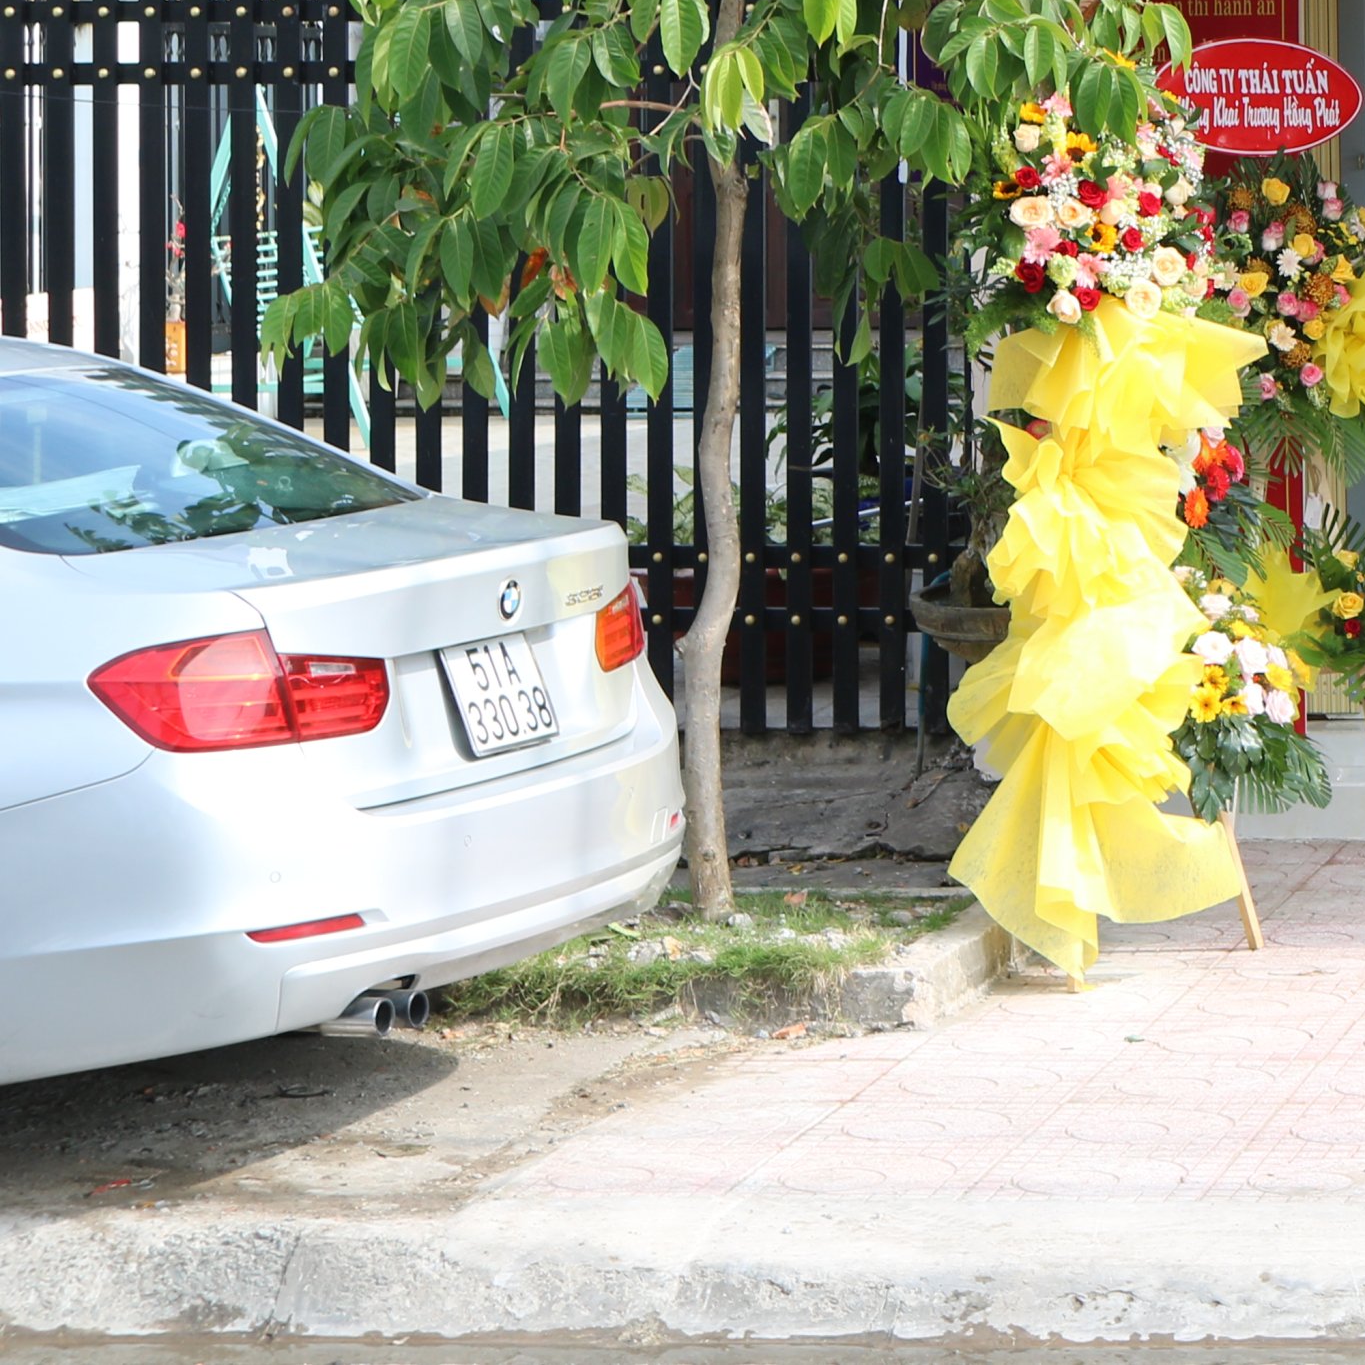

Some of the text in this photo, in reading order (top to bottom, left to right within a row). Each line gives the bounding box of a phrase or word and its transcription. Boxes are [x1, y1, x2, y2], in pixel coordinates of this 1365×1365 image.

[1184, 58, 1329, 94] CÔNG TY THÁI TUẤN
[1213, 96, 1240, 128] Khai
[1284, 96, 1313, 134] Hồng
[1314, 96, 1341, 128] Phát
[465, 641, 522, 691] 51A
[468, 686, 553, 745] 330.38
